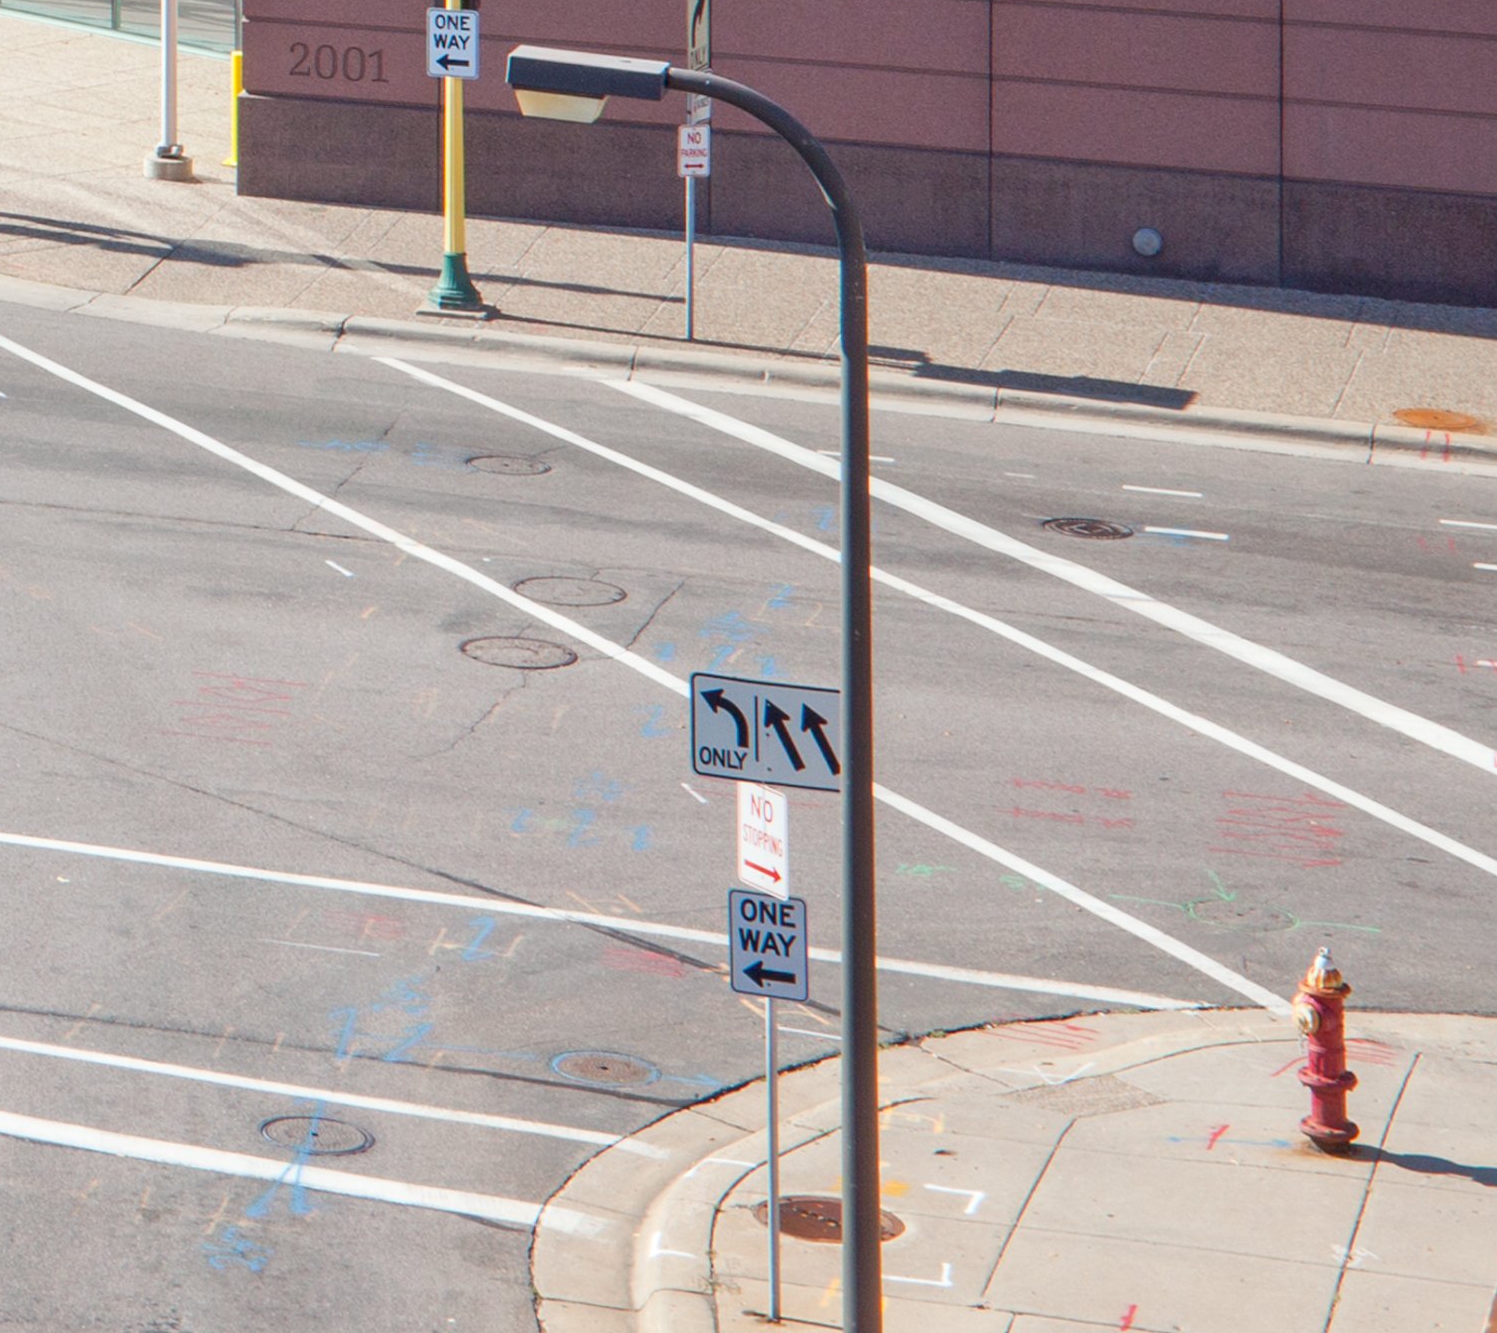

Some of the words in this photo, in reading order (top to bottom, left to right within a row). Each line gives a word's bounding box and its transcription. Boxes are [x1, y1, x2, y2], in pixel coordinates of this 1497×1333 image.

[434, 13, 471, 31] ONE
[433, 33, 471, 51] WAY
[288, 41, 390, 83] 2001
[687, 131, 702, 145] NO
[681, 147, 708, 158] PARKING
[699, 746, 748, 770] ONLY
[750, 793, 774, 823] NO
[742, 823, 784, 858] STOPPING
[740, 898, 796, 928] ONE
[739, 927, 797, 958] WAY
